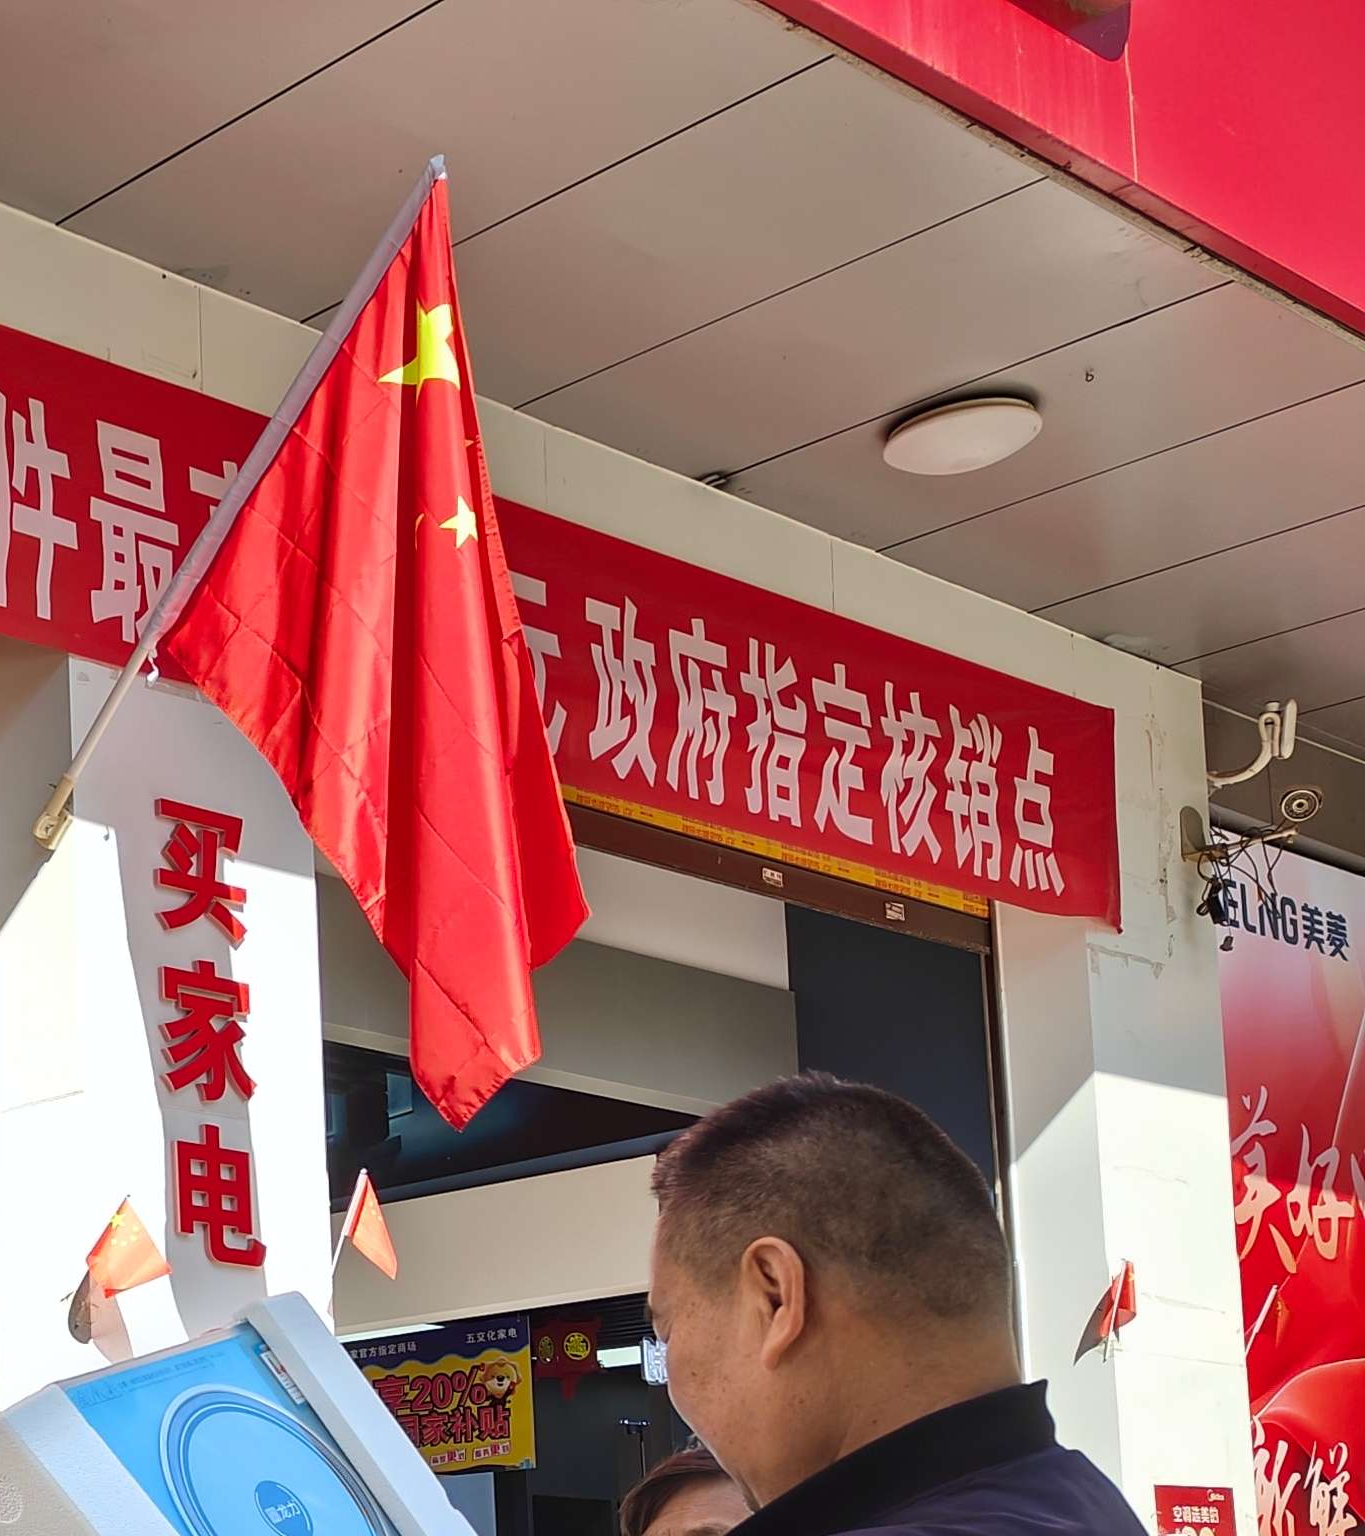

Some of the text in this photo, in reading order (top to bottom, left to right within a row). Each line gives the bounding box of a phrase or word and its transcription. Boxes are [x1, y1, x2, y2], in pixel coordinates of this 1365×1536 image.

[584, 596, 1066, 898] 政府指定核销点
[1301, 902, 1350, 962] 美菱
[154, 797, 267, 1270] 买家电
[1231, 1084, 1365, 1275] 美好
[466, 1327, 518, 1344] 五交化家电
